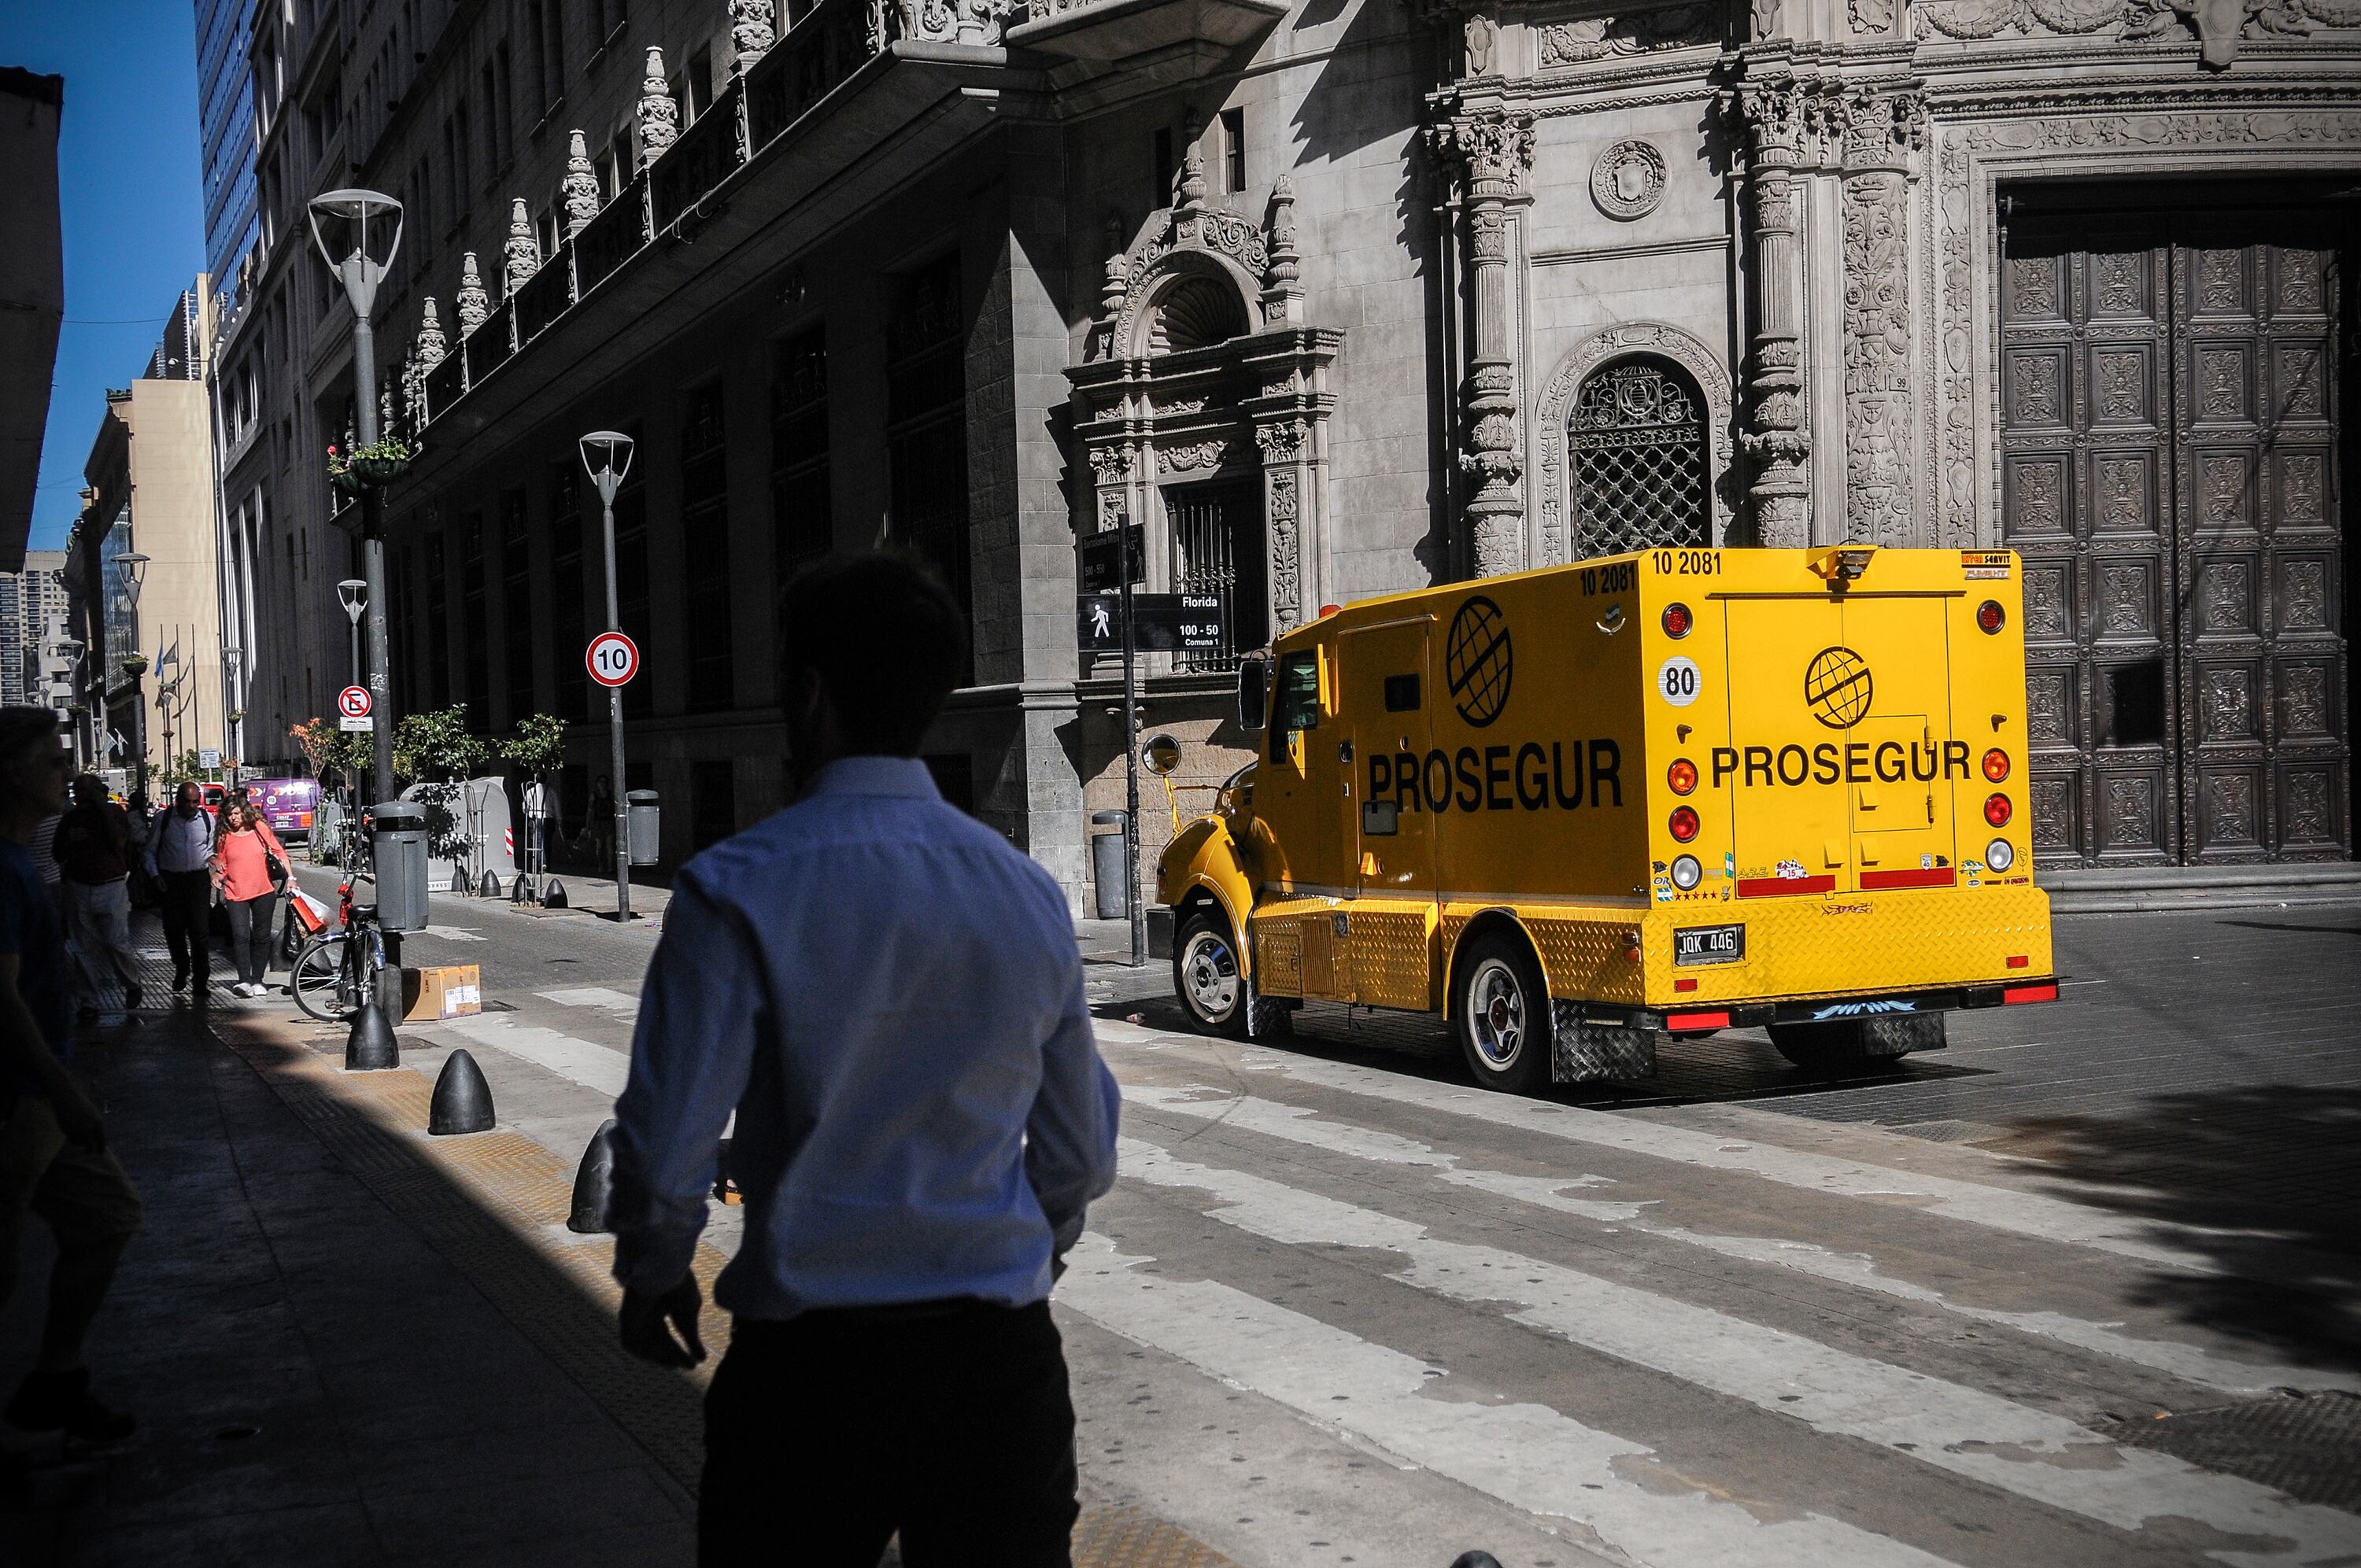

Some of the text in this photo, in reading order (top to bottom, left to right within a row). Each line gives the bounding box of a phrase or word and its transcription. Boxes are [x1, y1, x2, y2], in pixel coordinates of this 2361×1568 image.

[1653, 552, 1721, 575] 10 2081
[1984, 555, 2011, 563] SERVIT
[1580, 563, 1635, 596] 10 2081
[1182, 596, 1217, 607] Florida
[1179, 625, 1198, 636] 100
[1206, 625, 1218, 636] 50
[598, 648, 627, 670] 10
[1666, 667, 1694, 695] 80
[1711, 740, 1972, 788] PROSEGUR
[1369, 738, 1624, 814] PROSEGUR
[1787, 869, 1797, 877] 15
[1679, 932, 1734, 954] JQK 446
